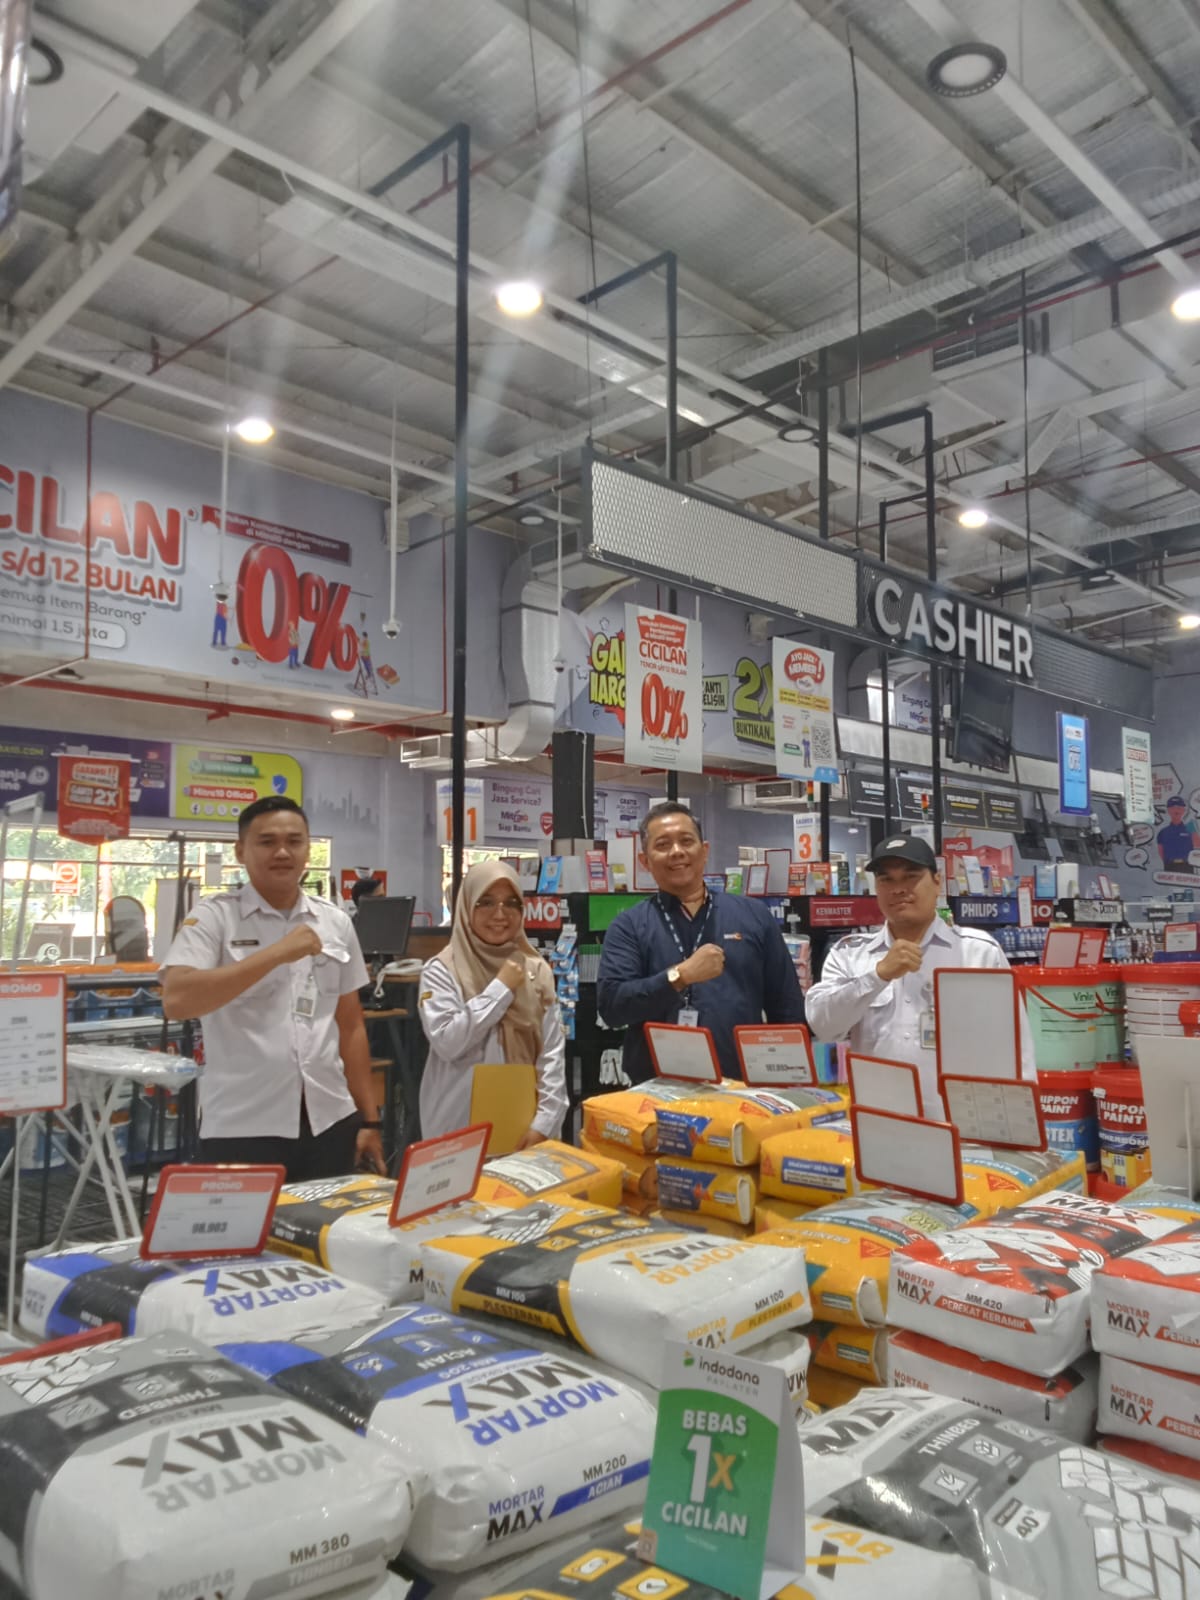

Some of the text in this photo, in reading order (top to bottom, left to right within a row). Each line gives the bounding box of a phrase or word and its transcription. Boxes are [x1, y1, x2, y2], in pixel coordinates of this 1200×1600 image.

[1, 547, 177, 603] s/d 12 BULAN
[50, 594, 84, 611] Item
[237, 543, 359, 672] 0%
[52, 620, 74, 634] 1.5
[874, 578, 1034, 679] CASHIER
[639, 640, 687, 666] CICILAN
[703, 681, 721, 694] ANTI
[641, 672, 688, 739] 0%
[94, 789, 117, 806] 2X
[491, 794, 541, 806] Jasa Service?
[492, 783, 523, 796] Bingung
[525, 784, 541, 795] Cari
[467, 807, 477, 841] 1
[498, 824, 531, 833] Siap Bantu
[799, 833, 812, 859] 3
[815, 907, 852, 916] KENMASTER
[961, 902, 998, 918] PHILIPS
[1104, 1111, 1144, 1125] PAINT
[1046, 1128, 1074, 1142] TEX
[201, 1181, 242, 1191] PROMO
[183, 1264, 331, 1296] MAX
[897, 1269, 935, 1289] MORTAR
[897, 1279, 932, 1305] MAX
[212, 1277, 346, 1317] MORTAR
[496, 1286, 526, 1304] MM 100
[755, 1289, 784, 1311] MM 100
[966, 1293, 1003, 1311] MM 420
[483, 1300, 544, 1326] PLESTERAN
[748, 1302, 793, 1328] PLESTERAN
[941, 1298, 1027, 1330] PEREKAT KERAMIK
[1107, 1299, 1150, 1320] MORTAR
[1107, 1310, 1150, 1338] MAX
[416, 1348, 476, 1371] ACIAN
[699, 1356, 760, 1386] indodana
[423, 1360, 592, 1423] MAX
[706, 1376, 759, 1396] PAYLATER
[894, 1369, 929, 1391] MORTAR
[118, 1388, 220, 1421] THINBED
[1110, 1384, 1153, 1409] MORTAR
[1110, 1394, 1152, 1425] MAX
[465, 1380, 618, 1447] MORTAR
[682, 1409, 747, 1436] BEBAS
[919, 1418, 981, 1456] THINBED
[113, 1416, 323, 1489] MAX
[153, 1443, 347, 1514] MORTAR
[583, 1454, 628, 1482] MM 200
[488, 1485, 545, 1515] MORTAR
[587, 1474, 623, 1500] ACIAN
[486, 1502, 545, 1542] MAX
[661, 1501, 748, 1537] CICILAN
[290, 1533, 351, 1567] MM 380
[288, 1553, 354, 1587] THINBED
[158, 1567, 236, 1600] MORTAR
